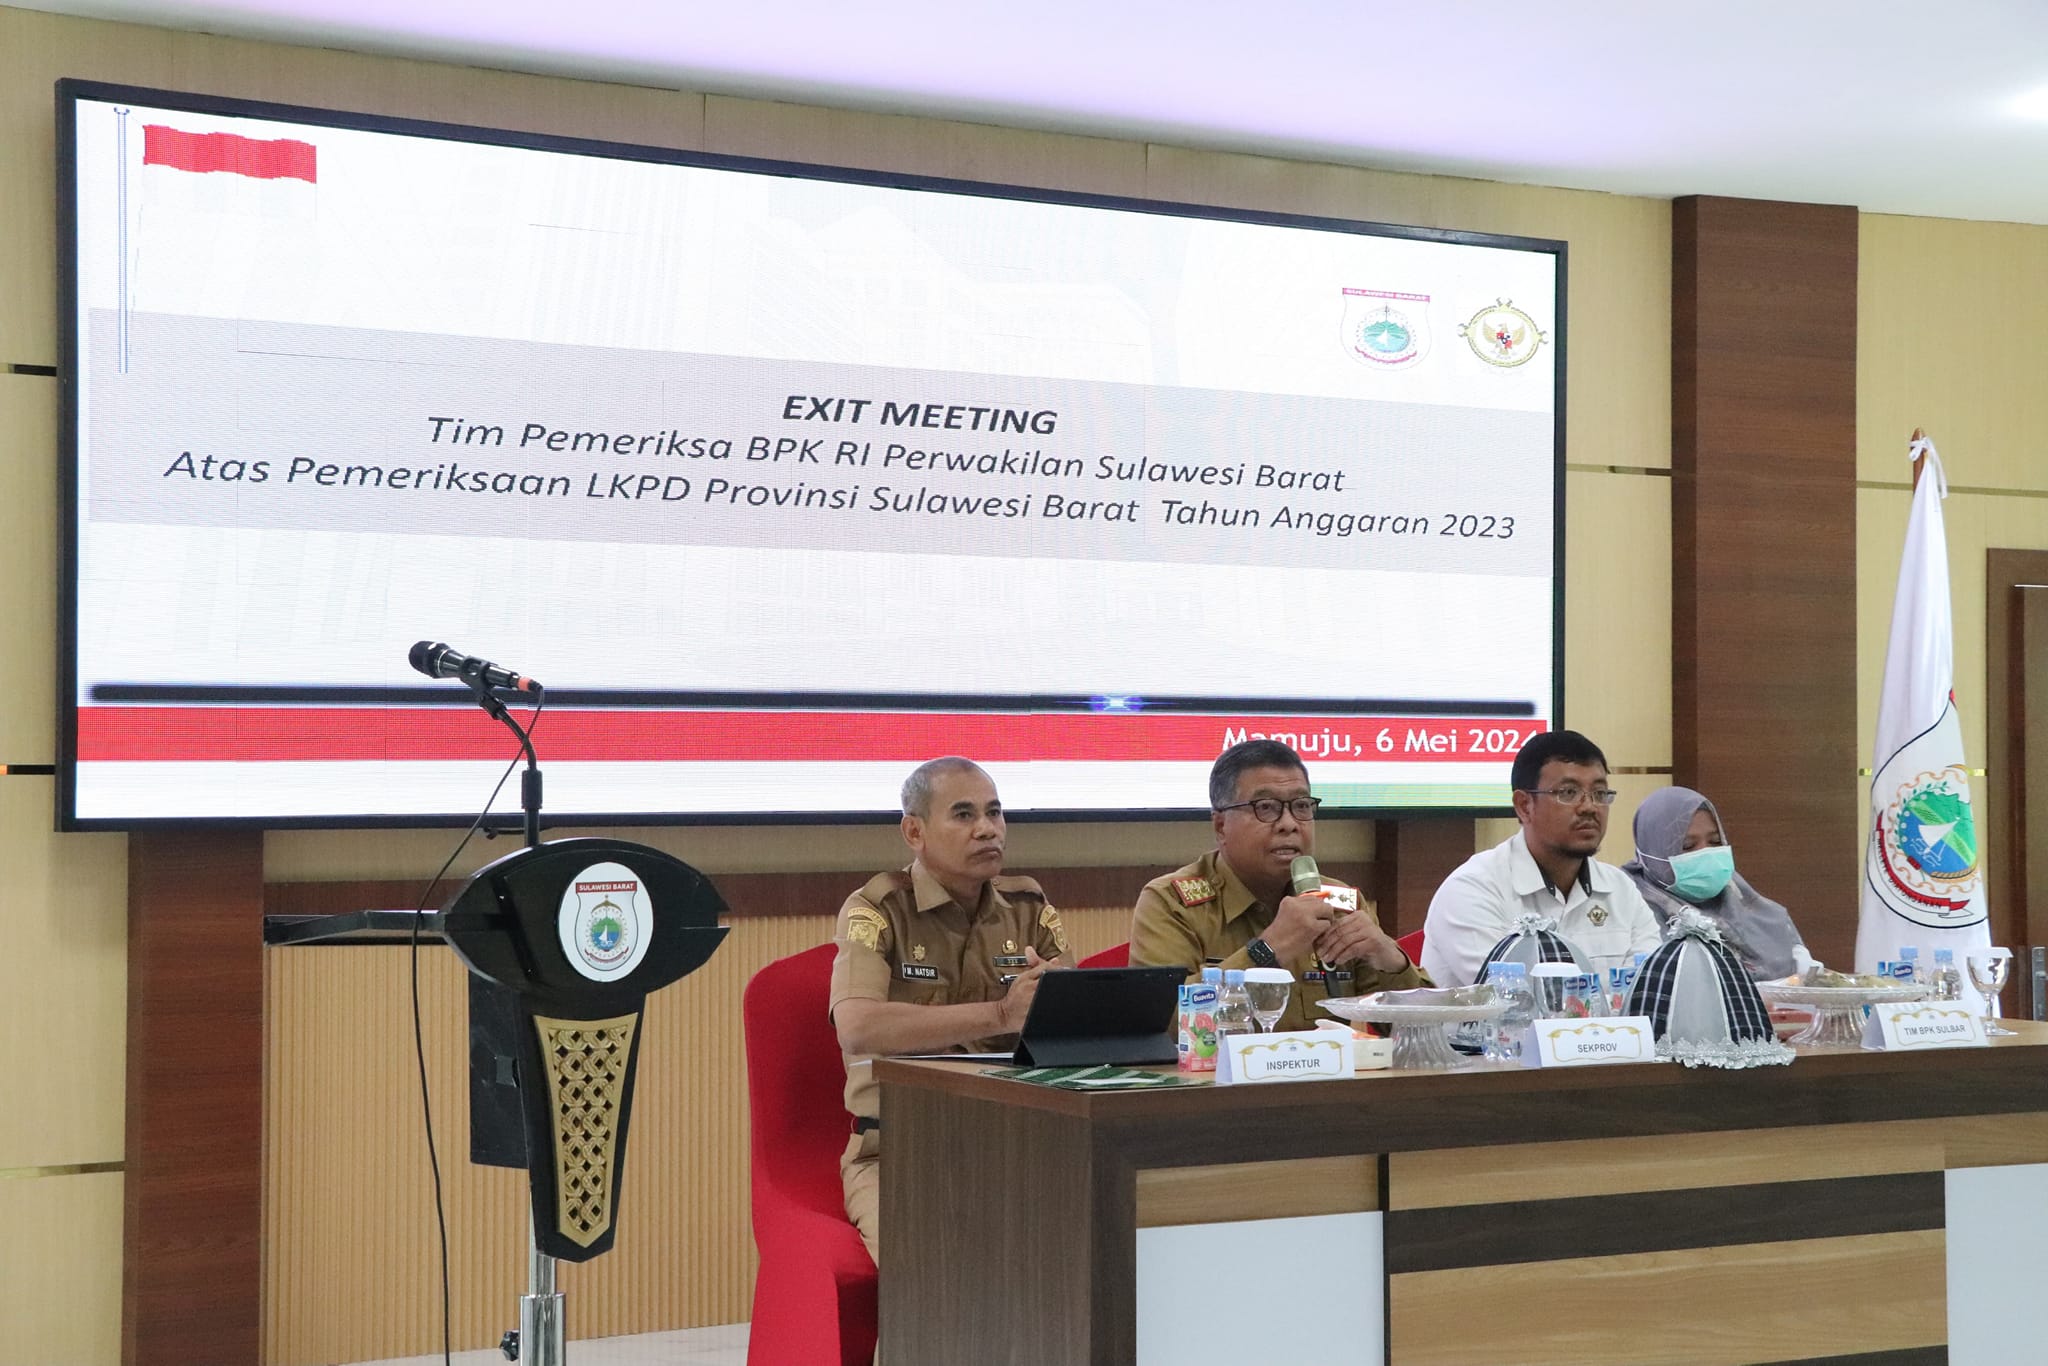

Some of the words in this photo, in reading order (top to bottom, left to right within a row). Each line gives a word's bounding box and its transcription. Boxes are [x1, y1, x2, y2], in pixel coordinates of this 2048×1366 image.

[782, 395, 872, 424] EXIT
[880, 401, 1058, 435] MEETING
[428, 416, 504, 446] Tim
[519, 423, 733, 460] Pemeriksa
[746, 436, 824, 464] BPK
[834, 440, 871, 466] RI
[883, 443, 1084, 477] Perwakilan
[1095, 455, 1246, 486] Sulawesi
[1255, 464, 1346, 492] Barat
[163, 451, 271, 483] Atas
[287, 456, 570, 497] Pemeriksaan
[586, 472, 691, 501] LKPD
[704, 478, 860, 510] Provinsi
[869, 486, 1032, 517] Sulawesi
[1042, 494, 1140, 523] Barat
[1161, 499, 1260, 527] Tahun
[1270, 506, 1429, 537] Anggaran
[1439, 513, 1515, 539] 2023
[1375, 728, 1394, 753] 6
[1404, 728, 1457, 753] Mei
[914, 967, 936, 977] NATSIR
[1904, 1026, 1918, 1036] TIM
[1919, 1025, 1935, 1035] BPK
[1936, 1024, 1966, 1034] SULBAR
[1577, 1042, 1617, 1053] SEKPROV
[1266, 1058, 1321, 1071] INSPEKTUR
